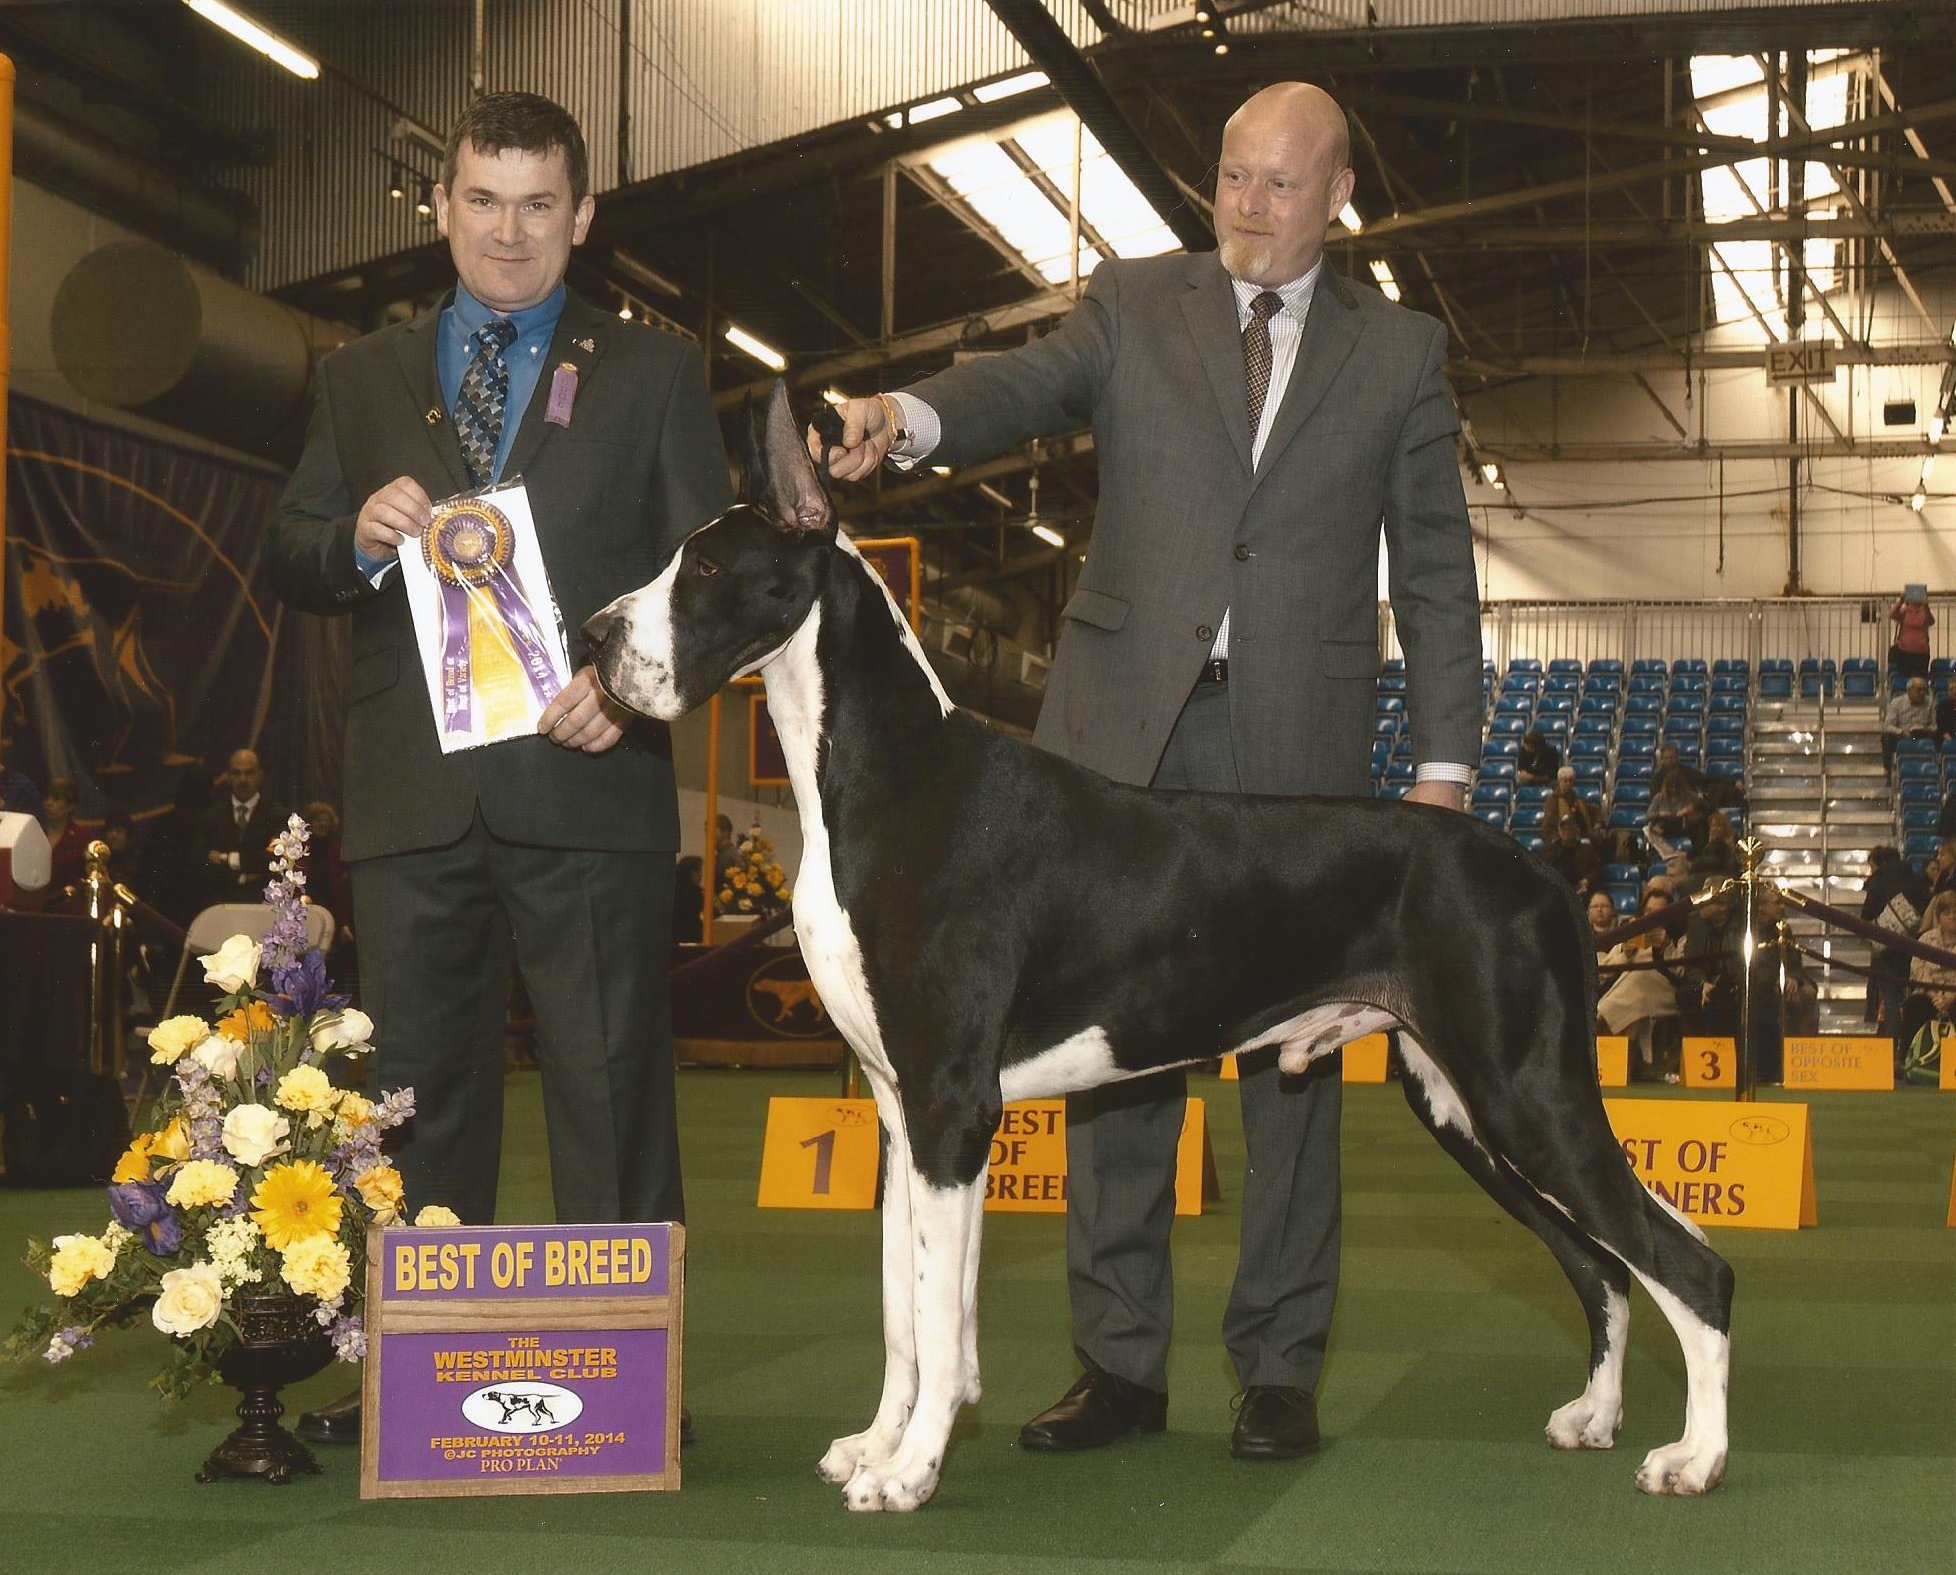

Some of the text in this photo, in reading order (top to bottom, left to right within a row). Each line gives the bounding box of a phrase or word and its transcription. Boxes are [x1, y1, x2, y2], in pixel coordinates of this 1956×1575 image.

[1771, 349, 1831, 373] EXIT
[528, 650, 549, 679] 2014
[1790, 1043, 1853, 1055] BEST OF
[1700, 1051, 1721, 1081] 3
[1790, 1057, 1862, 1069] OPPOSITE
[1790, 1070, 1818, 1082] SEX
[998, 1109, 1062, 1135] EST
[800, 1129, 836, 1195] 1
[1677, 1139, 1728, 1174] OF
[395, 1238, 653, 1291] BEST OF BREED
[508, 1337, 540, 1349] THE
[433, 1347, 618, 1370] WESTMINSTER
[436, 1367, 618, 1383] KENNEL CLUB
[430, 1432, 626, 1449] FEBRUARY 10-11, 2014
[480, 1446, 601, 1459] PHOTOGRAPHY
[480, 1459, 513, 1473] PRO
